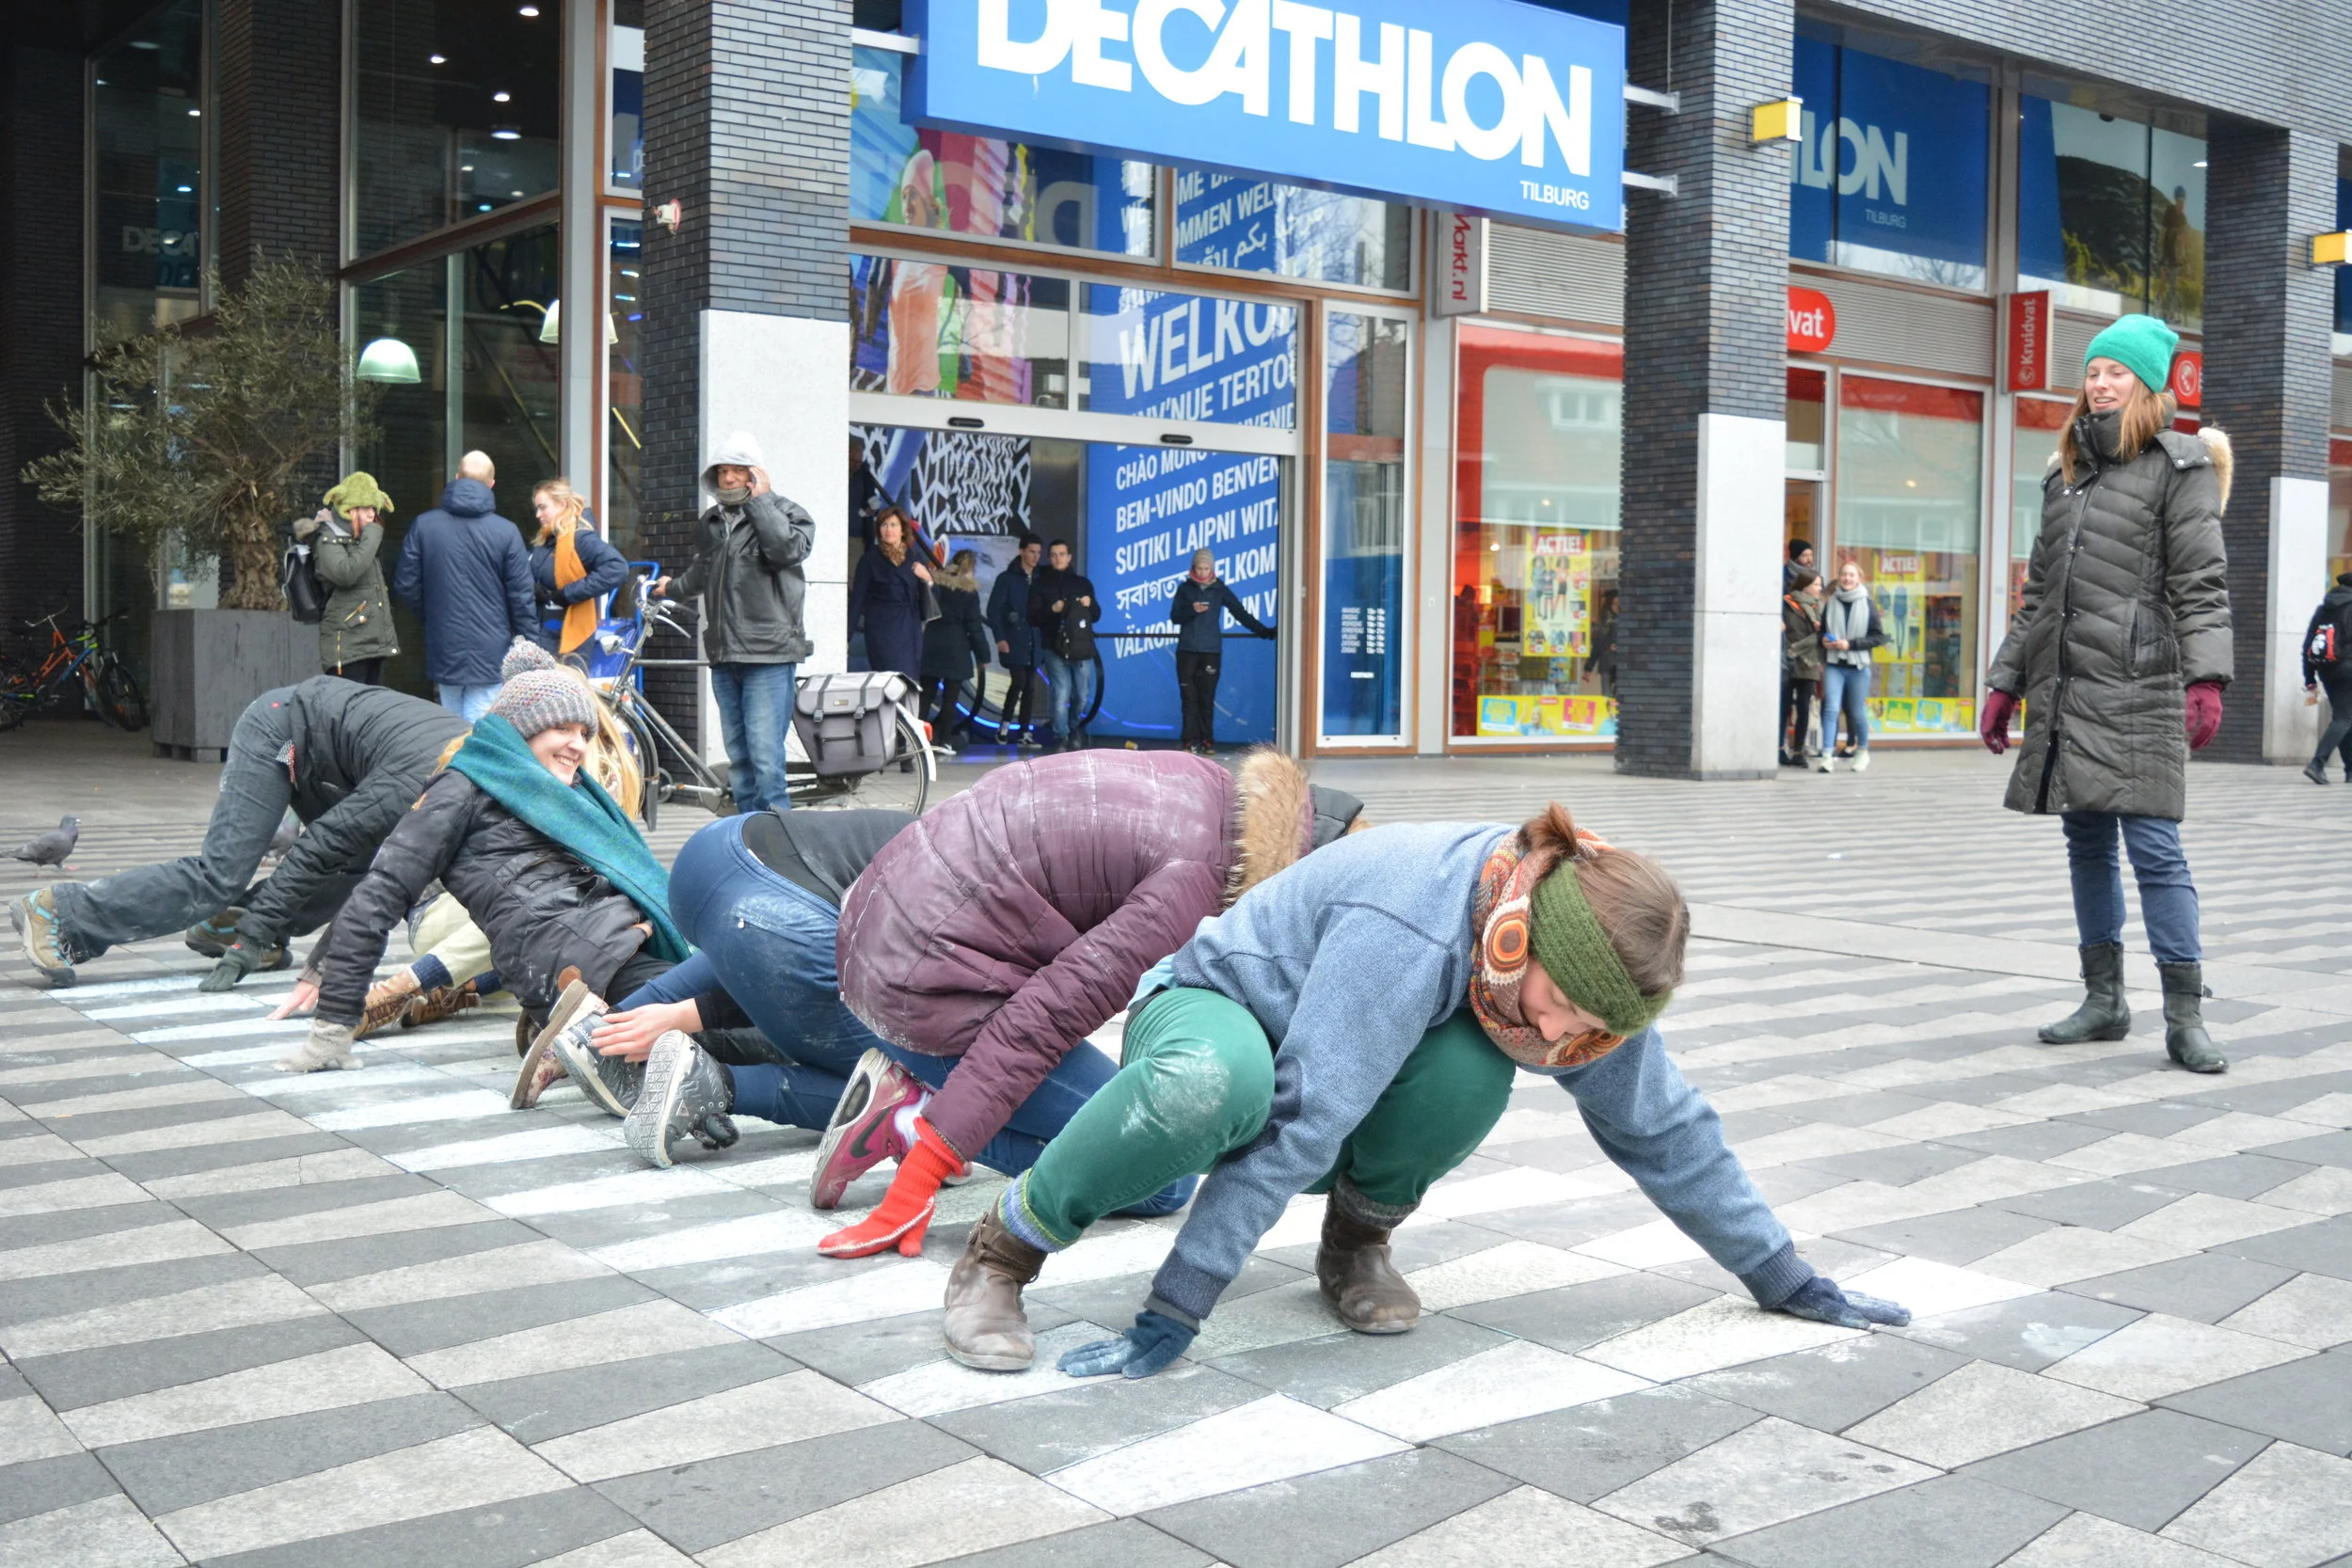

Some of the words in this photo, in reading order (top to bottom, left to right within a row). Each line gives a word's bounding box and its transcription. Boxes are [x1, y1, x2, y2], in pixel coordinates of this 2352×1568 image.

[977, 0, 1591, 176] DECATHLON
[1519, 180, 1591, 211] TILBURG
[1865, 209, 1907, 229] TILBURG
[2020, 298, 2036, 365] Kruidvat
[1116, 477, 1208, 533] BEM-VINDO
[1115, 531, 1170, 576] SUTIKI
[1176, 509, 1236, 557] LAIPNI
[1214, 543, 1277, 586] ELKOM
[1535, 534, 1581, 555] ACTIE!
